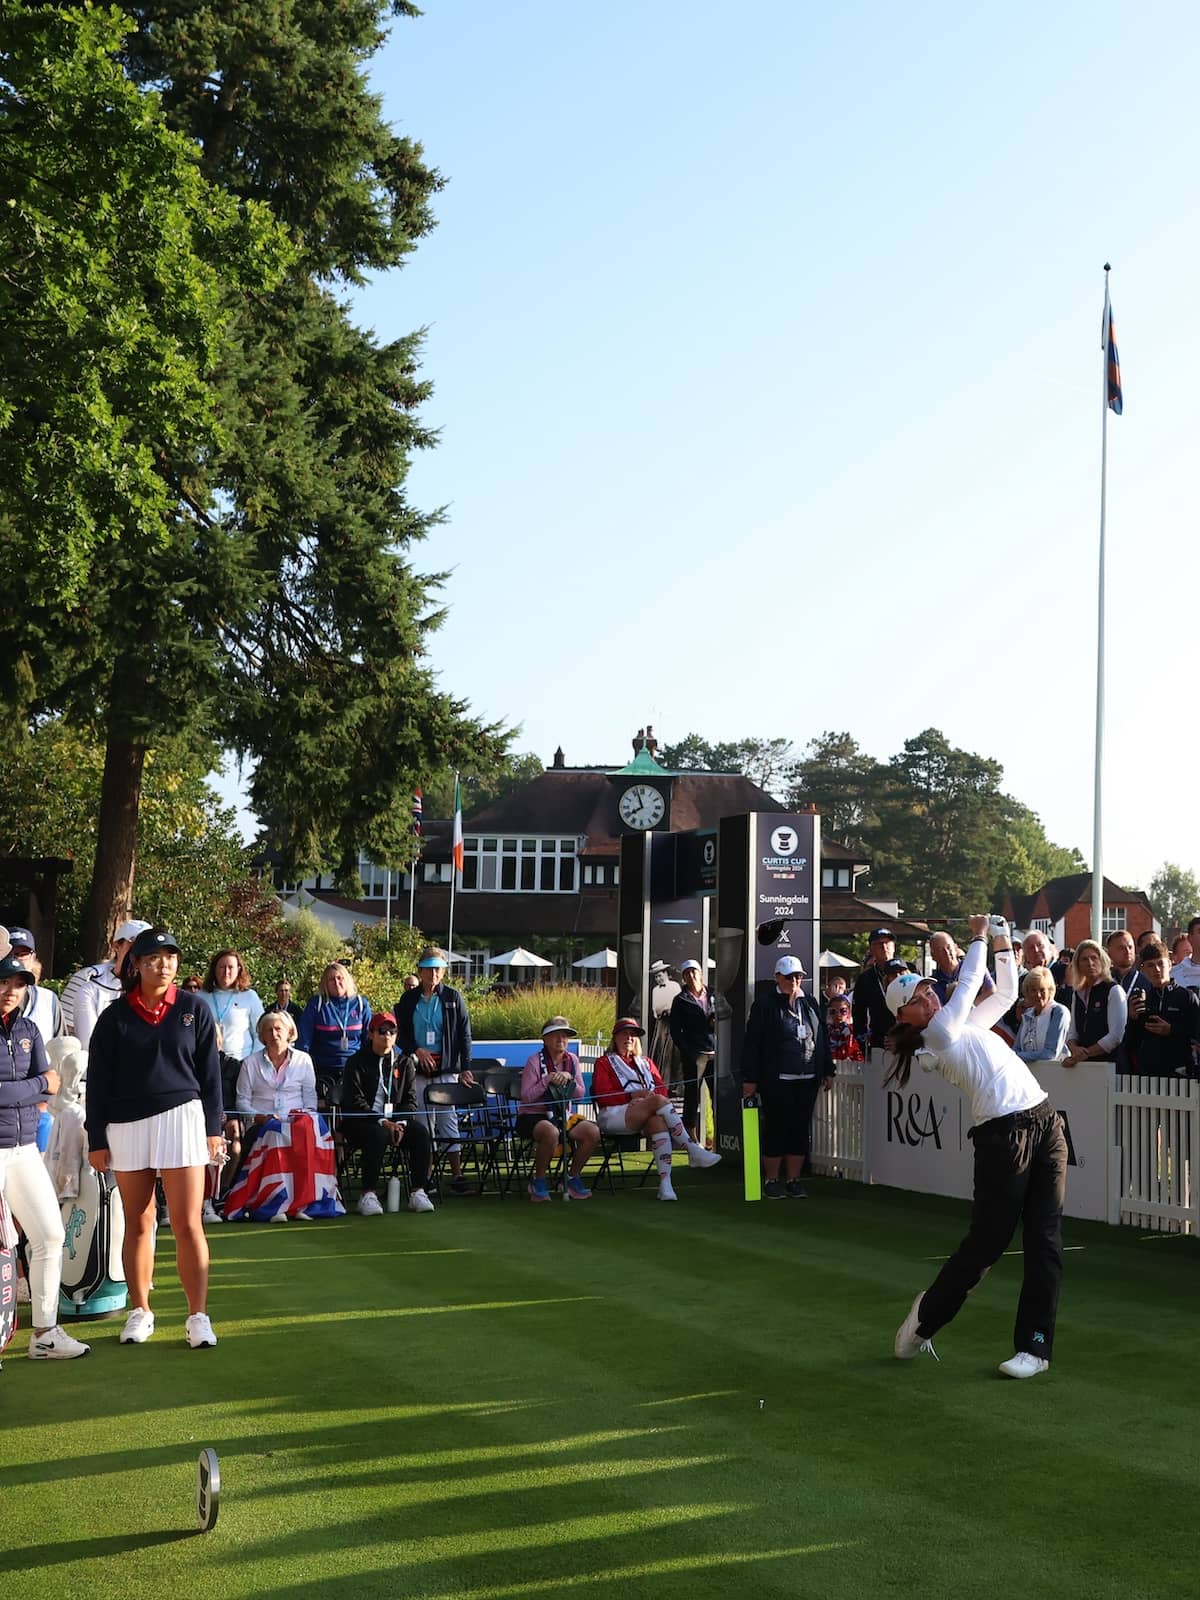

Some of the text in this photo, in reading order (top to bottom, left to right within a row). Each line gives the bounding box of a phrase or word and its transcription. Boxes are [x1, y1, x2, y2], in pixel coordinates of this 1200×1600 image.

[762, 857, 789, 865] CURTIS
[760, 894, 809, 905] Sunningdale
[774, 907, 794, 915] 2024
[888, 1091, 947, 1150] R&A
[720, 1134, 740, 1151] USGA
